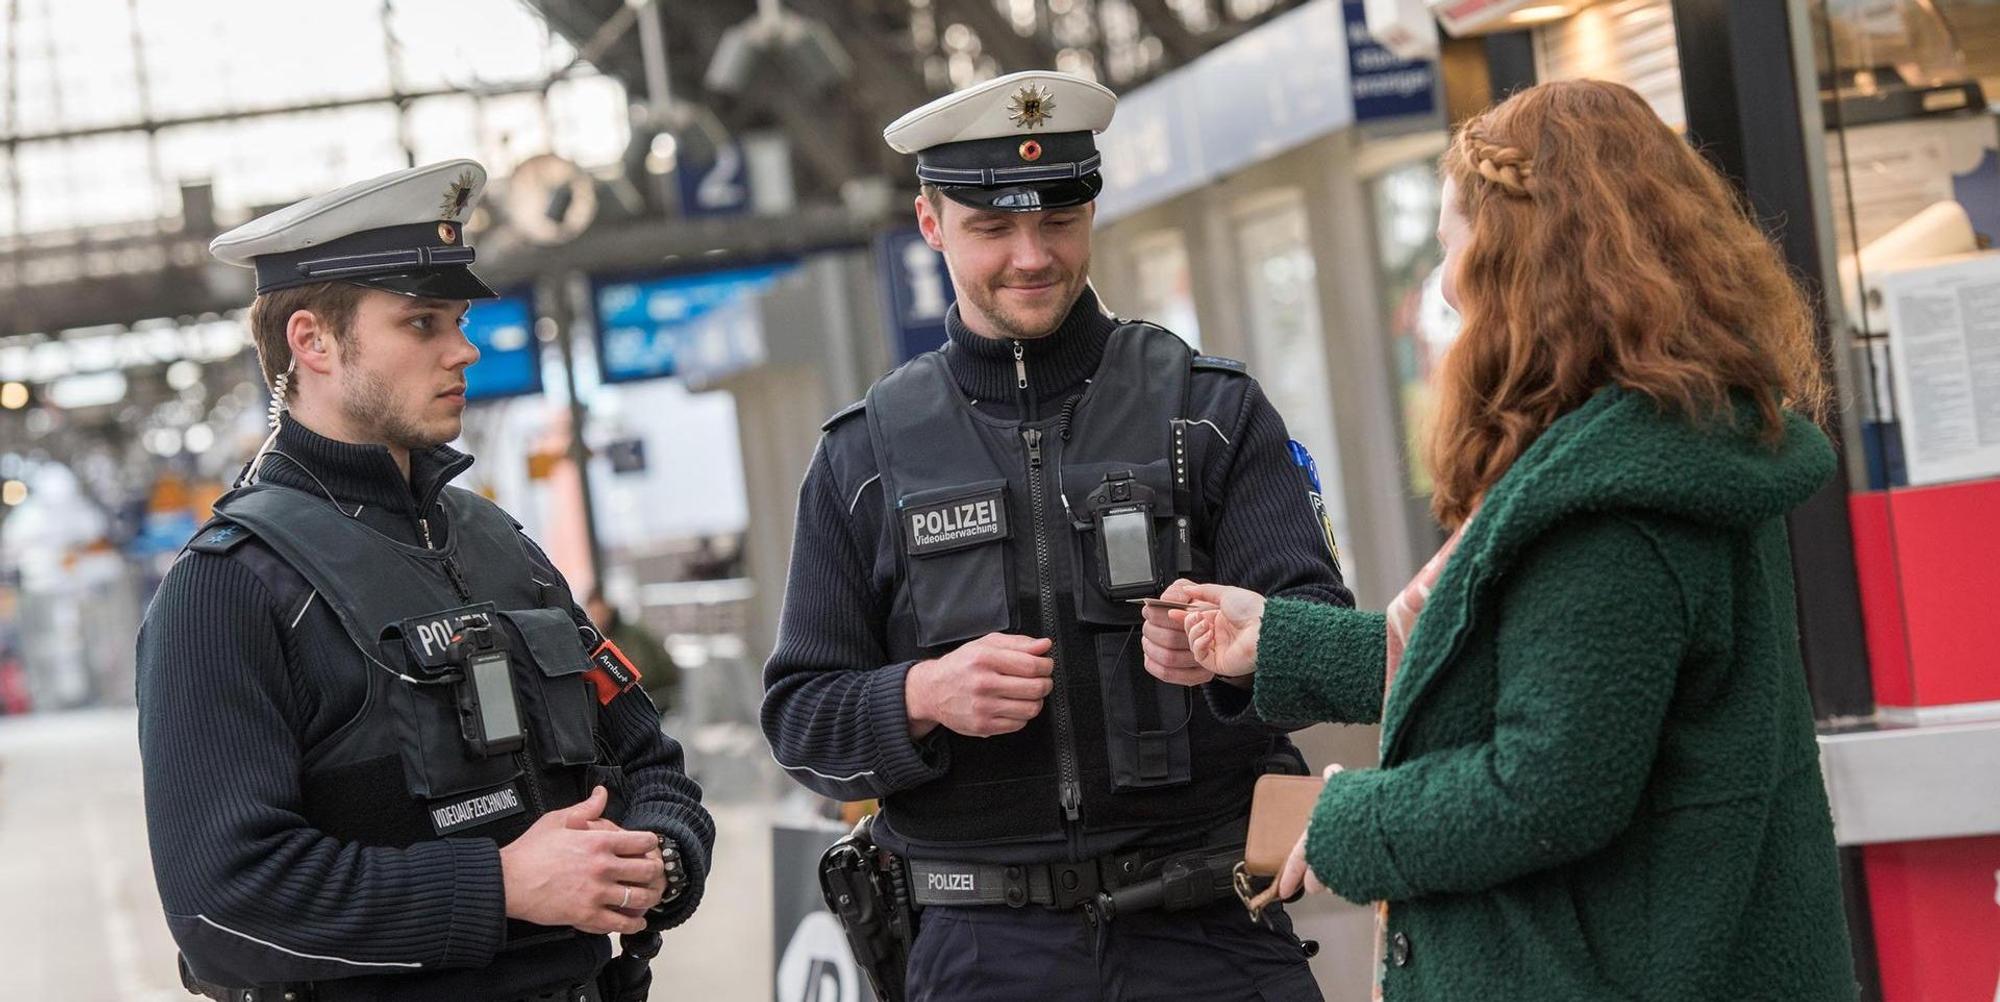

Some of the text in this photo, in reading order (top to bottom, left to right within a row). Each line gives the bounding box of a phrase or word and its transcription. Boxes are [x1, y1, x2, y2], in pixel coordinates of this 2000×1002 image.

[912, 499, 997, 537] POLIZEI
[914, 523, 998, 546] Videoüberwachung
[600, 654, 625, 682] Ambu
[432, 788, 518, 829] VIDEOAUFZEICHNUNG
[928, 873, 974, 890] POLIZEI
